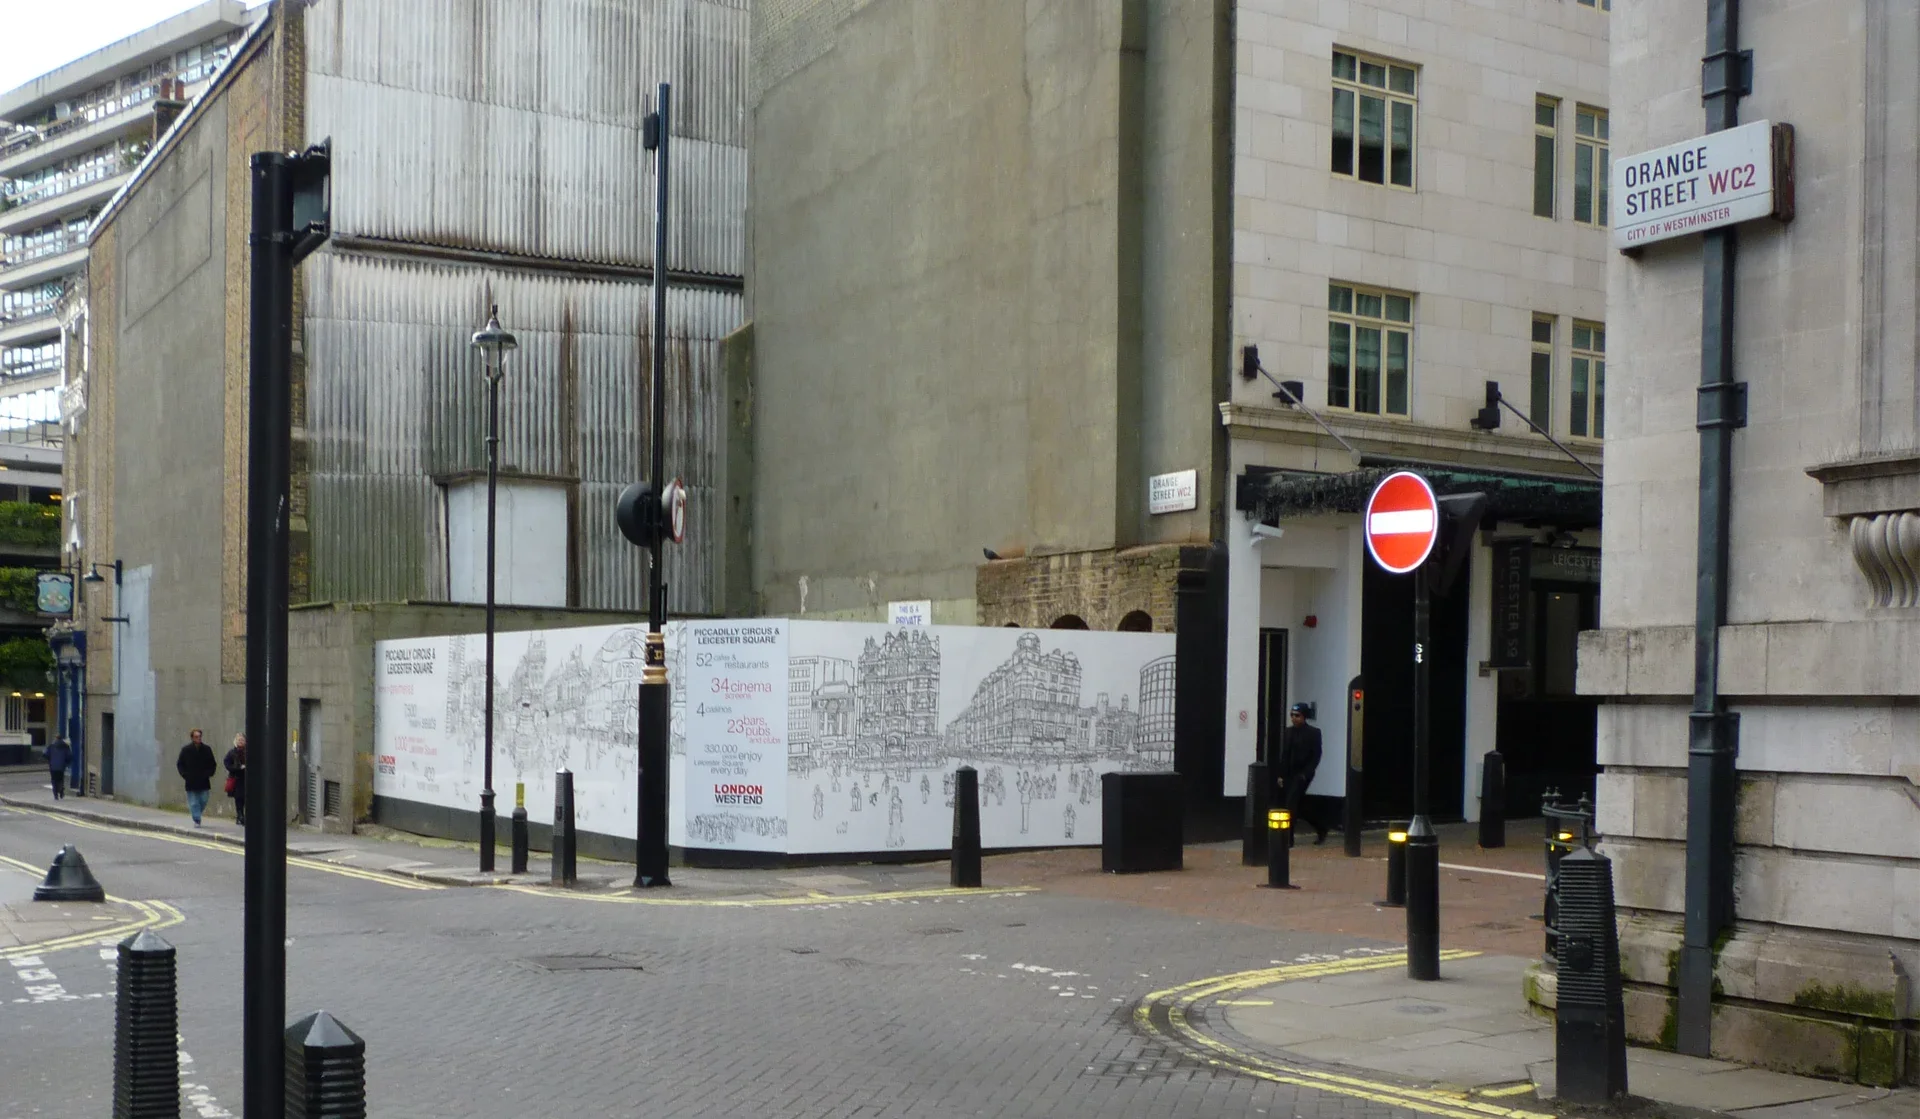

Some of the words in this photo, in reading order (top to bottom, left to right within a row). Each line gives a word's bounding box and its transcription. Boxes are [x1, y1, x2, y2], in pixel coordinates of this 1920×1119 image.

[1625, 146, 1708, 188] ORANGE
[1626, 177, 1700, 216] STREET
[1708, 163, 1756, 196] WC2
[1627, 227, 1647, 241] CITY
[1649, 223, 1661, 236] OF
[1663, 206, 1731, 232] WESTMINSTER
[1152, 476, 1179, 489] ORANGE
[1153, 488, 1175, 501] STREET
[1177, 486, 1192, 498] WC2
[1508, 546, 1522, 631] LEICESTER
[899, 605, 908, 613] THIS
[909, 605, 914, 613] IS
[895, 615, 922, 625] PRIVATE
[694, 627, 740, 636] PICCADILLY
[741, 627, 772, 635] CIRCUS
[774, 627, 780, 635] &
[697, 636, 741, 645] LEICESTER
[742, 636, 776, 644] SQUARE
[385, 648, 412, 660] PICCADILLY
[412, 647, 431, 660] CIRCUS
[695, 652, 713, 667] 52
[387, 662, 412, 674] LEICESTER
[413, 662, 433, 674] SQUARE
[724, 660, 769, 669] restaurants
[710, 677, 729, 693] 34
[730, 680, 772, 692] cinema
[696, 701, 706, 718] 4
[705, 705, 733, 713] casinos
[743, 714, 768, 726] bars,
[726, 719, 744, 734] 23
[745, 726, 771, 738] pubs
[704, 744, 738, 754] 330,000
[378, 754, 396, 766] LONDON
[693, 758, 720, 767] Leicester
[721, 759, 744, 768] Square
[738, 751, 763, 763] enjoy
[710, 767, 732, 776] every
[733, 766, 748, 777] day
[714, 783, 763, 795] LONDON
[714, 794, 742, 804] WEST
[743, 795, 763, 805] END
